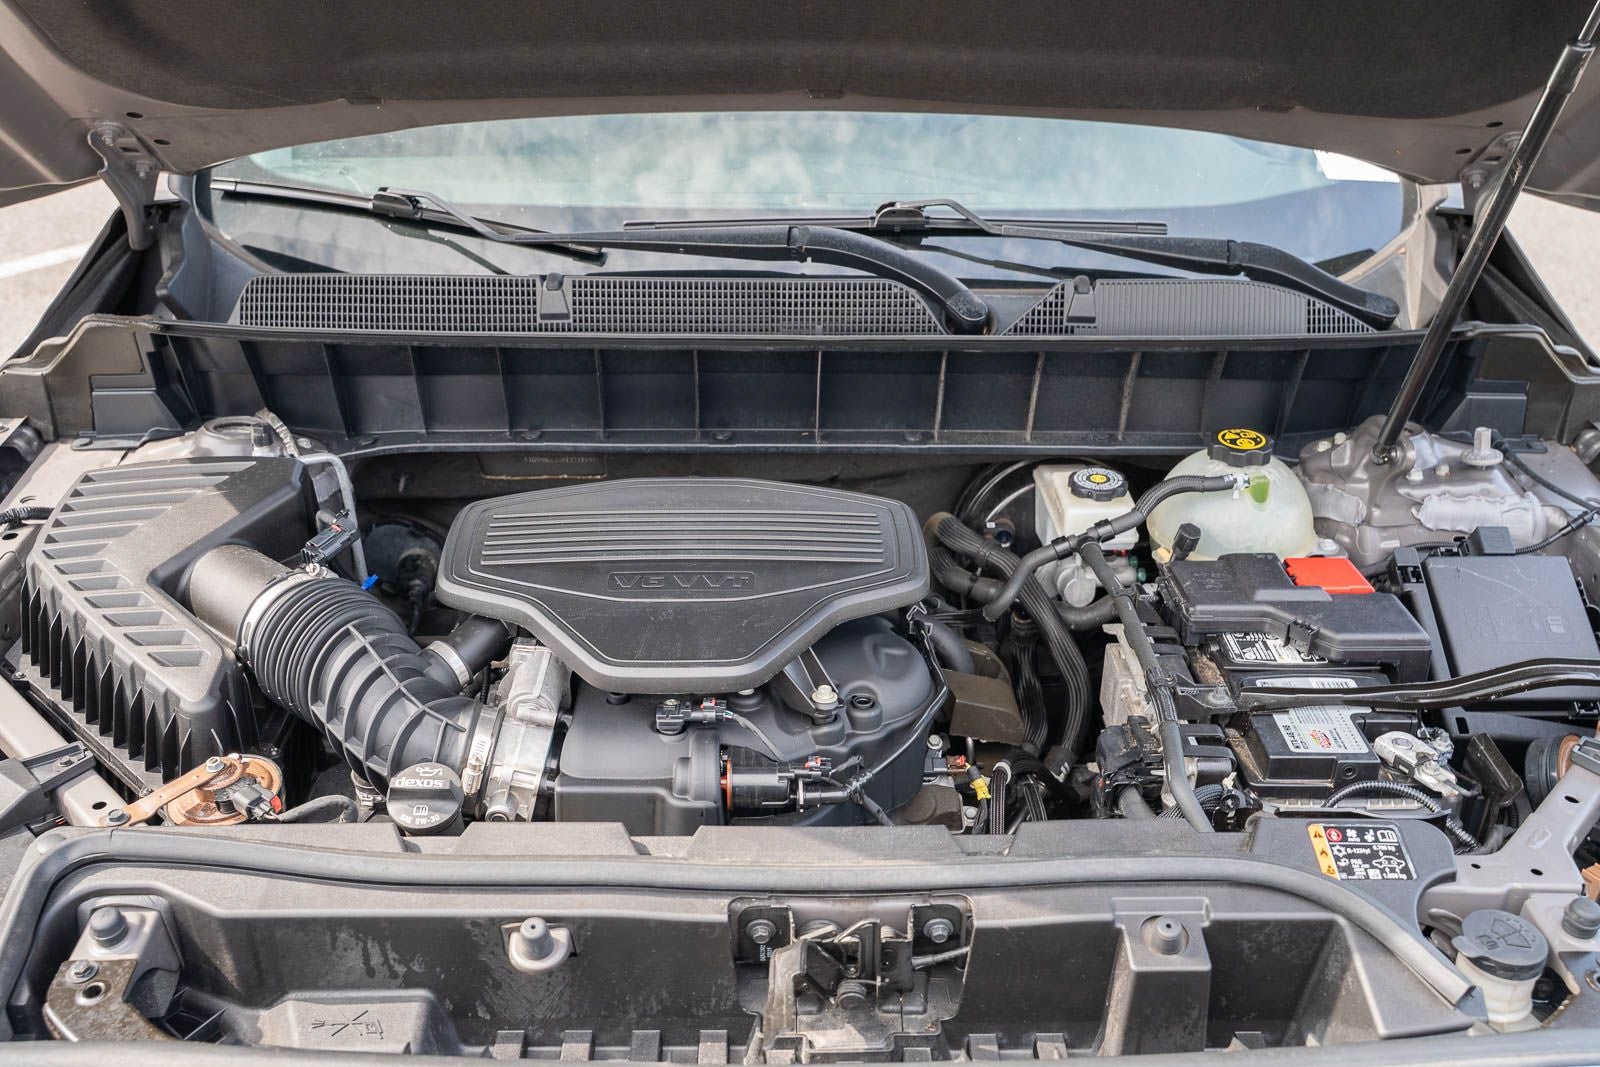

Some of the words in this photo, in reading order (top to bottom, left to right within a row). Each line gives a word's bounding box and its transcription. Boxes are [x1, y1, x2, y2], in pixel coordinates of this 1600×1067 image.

[614, 574, 665, 588] V6
[673, 574, 750, 588] VVT
[395, 777, 444, 787] dexos
